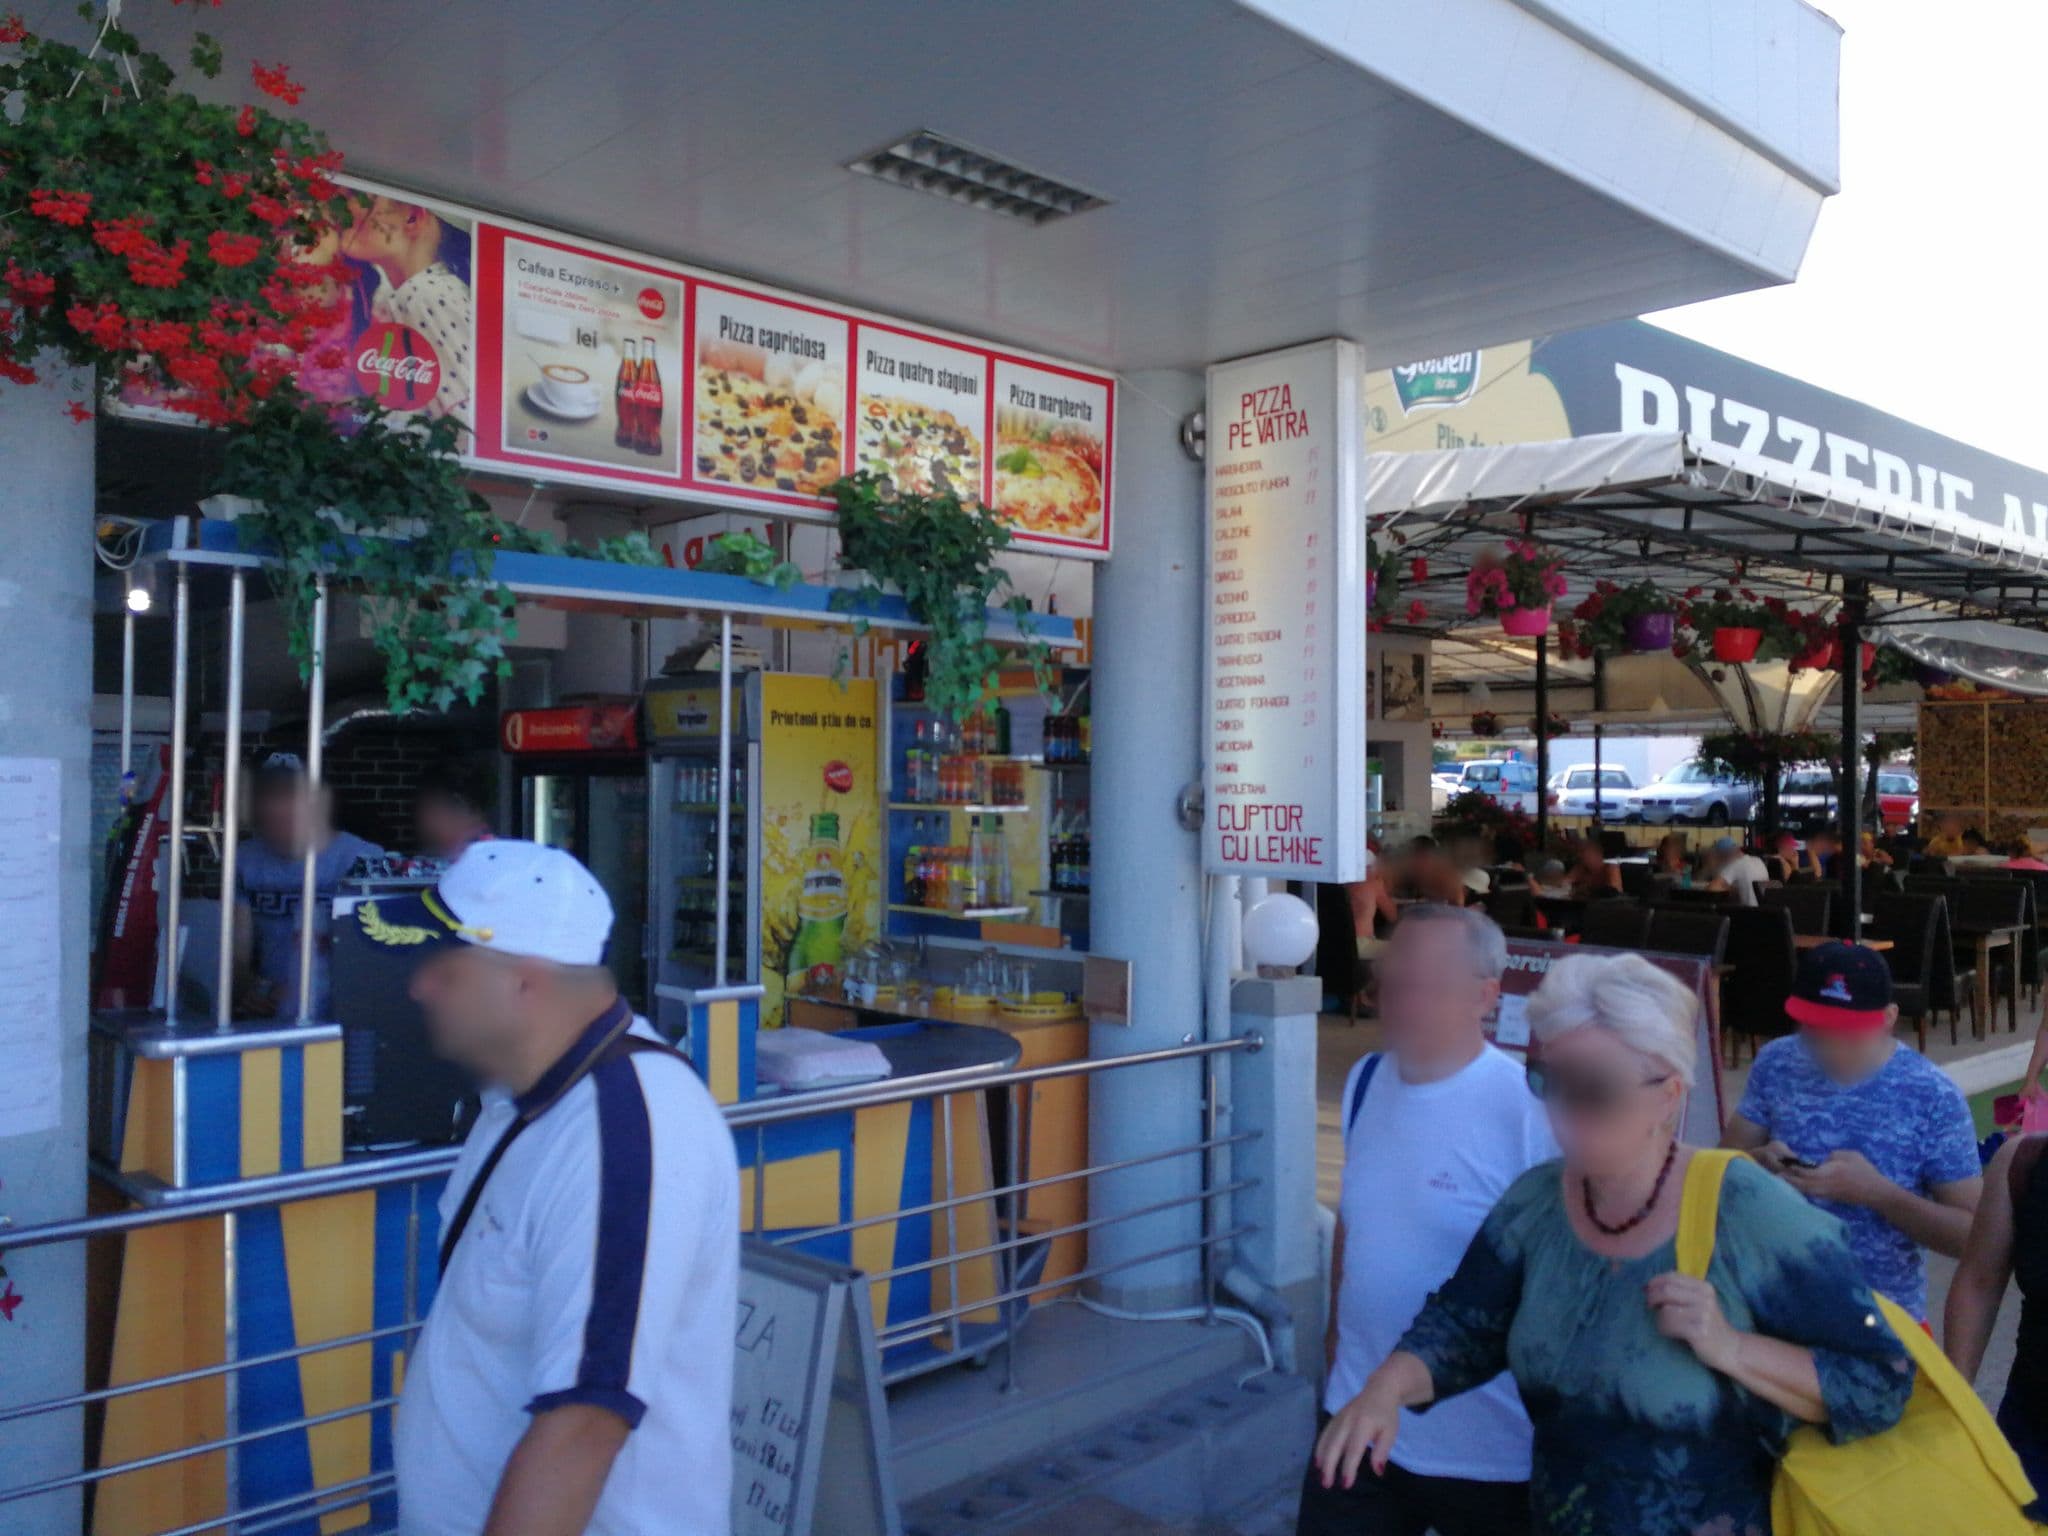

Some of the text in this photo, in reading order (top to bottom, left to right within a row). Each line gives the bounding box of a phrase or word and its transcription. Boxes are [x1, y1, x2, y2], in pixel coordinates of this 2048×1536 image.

[518, 258, 555, 279] Cafea
[559, 268, 609, 292] Expreso
[576, 328, 598, 349] lei
[720, 315, 826, 361] Pizza capriciosa
[357, 348, 437, 385] Coca-Cola
[866, 349, 978, 396] Pizza quatro stagioni
[1010, 383, 1092, 422] Pizza margherita
[1241, 383, 1292, 419] PIZZA
[1228, 409, 1310, 451] PE VATRA
[1217, 804, 1303, 832] CUPTOR
[1221, 835, 1323, 865] CU LEMNE
